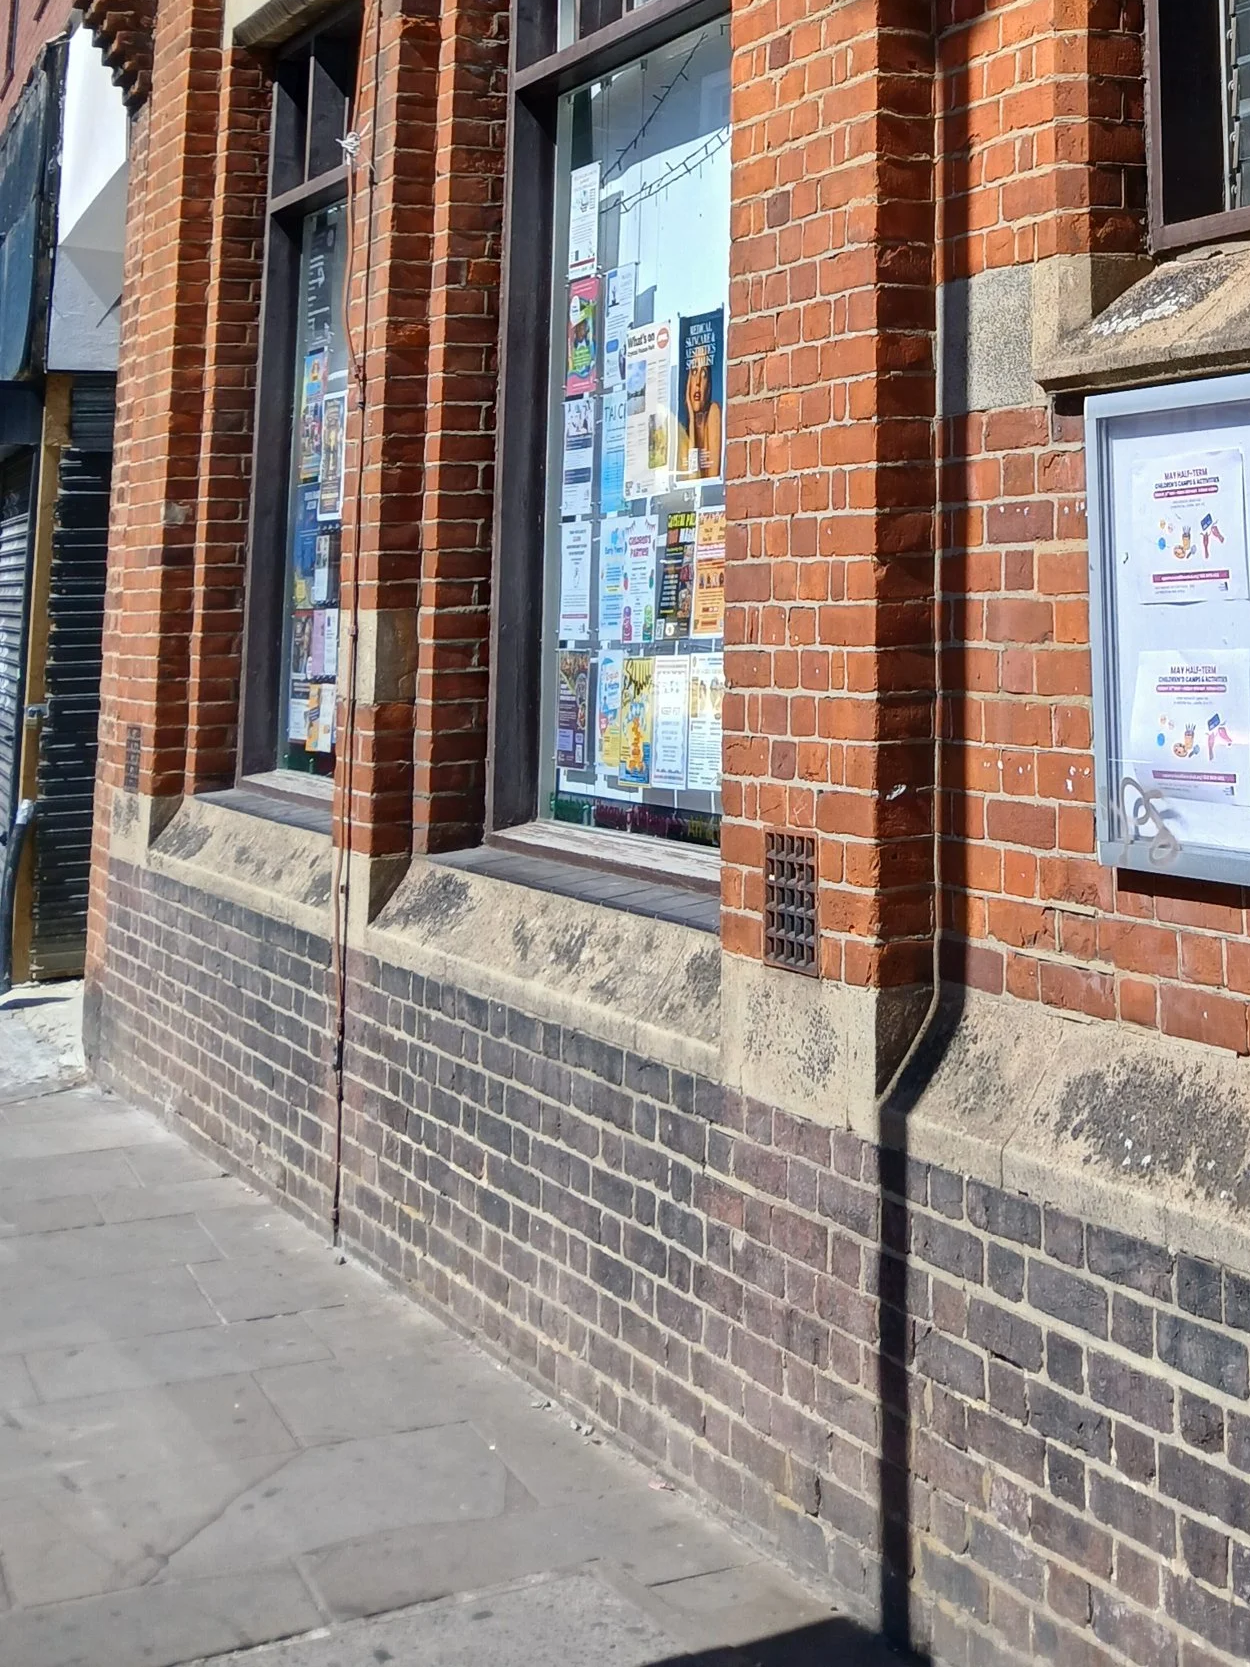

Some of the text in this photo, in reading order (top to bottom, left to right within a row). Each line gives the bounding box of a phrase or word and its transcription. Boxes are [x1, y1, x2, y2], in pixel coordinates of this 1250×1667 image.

[690, 321, 712, 335] MEDICAL
[628, 333, 647, 349] What's
[648, 332, 655, 342] on
[1164, 468, 1208, 480] MAY HALF-TERM
[1155, 481, 1177, 489] CHILDREN'S
[1197, 476, 1219, 484] ACTIVITIES
[1170, 666, 1216, 674] MAY HALF-TERM
